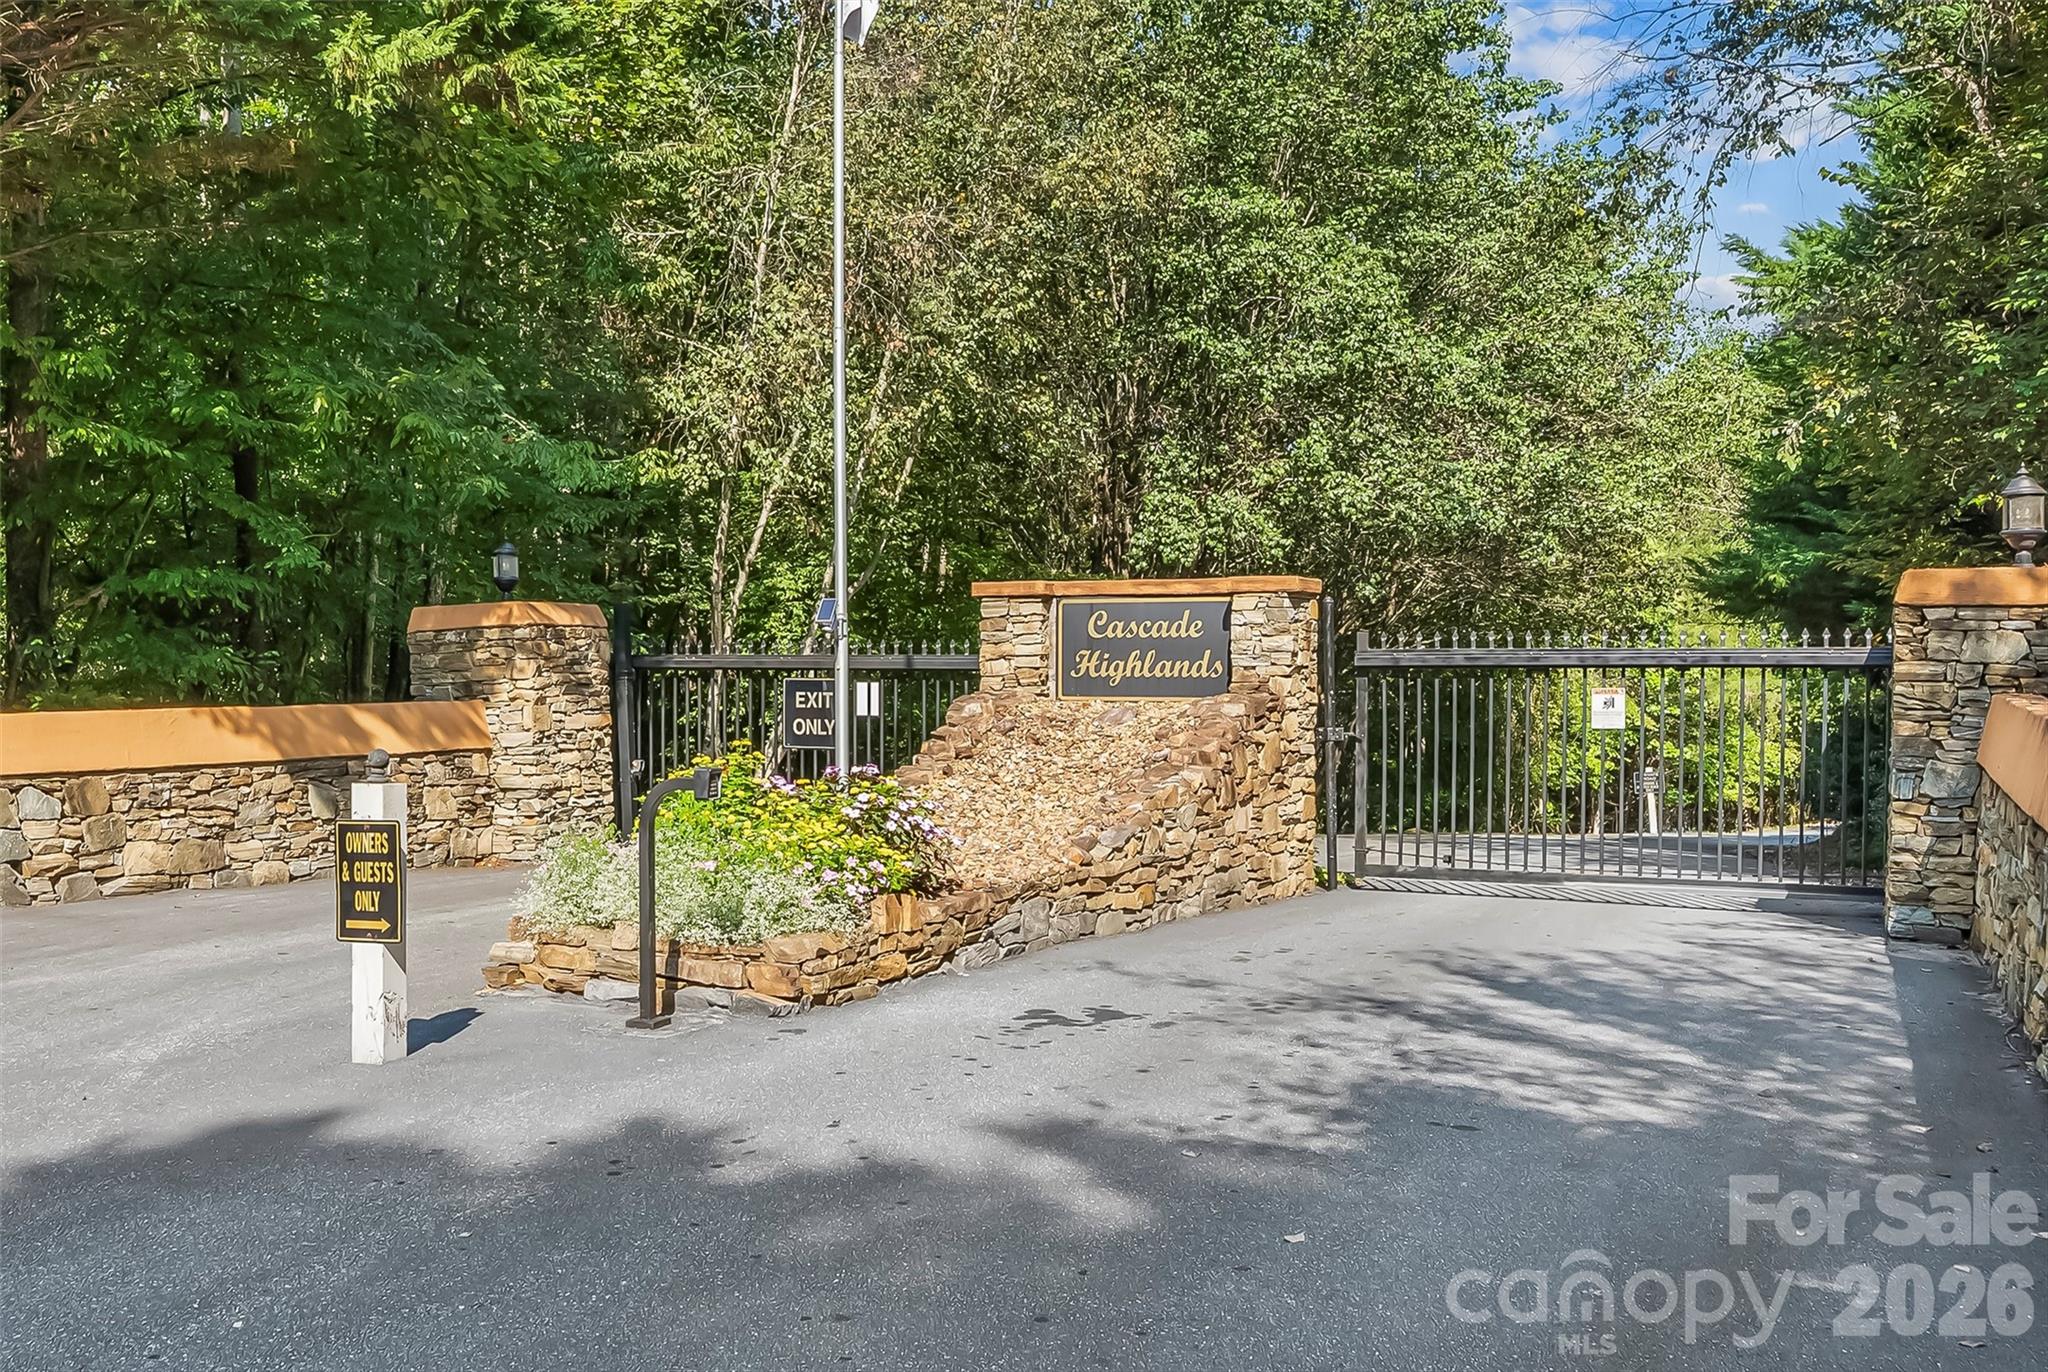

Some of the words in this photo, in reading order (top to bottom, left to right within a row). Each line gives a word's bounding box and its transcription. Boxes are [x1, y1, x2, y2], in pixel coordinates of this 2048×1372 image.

[1087, 609, 1204, 639] Cascade
[1070, 649, 1224, 687] Highlands
[795, 691, 834, 709] EXIT
[792, 718, 835, 736] ONLY
[346, 832, 388, 854] OWNERS
[342, 861, 349, 881] &
[354, 862, 394, 883] GUESTS
[355, 890, 380, 911] ONLY
